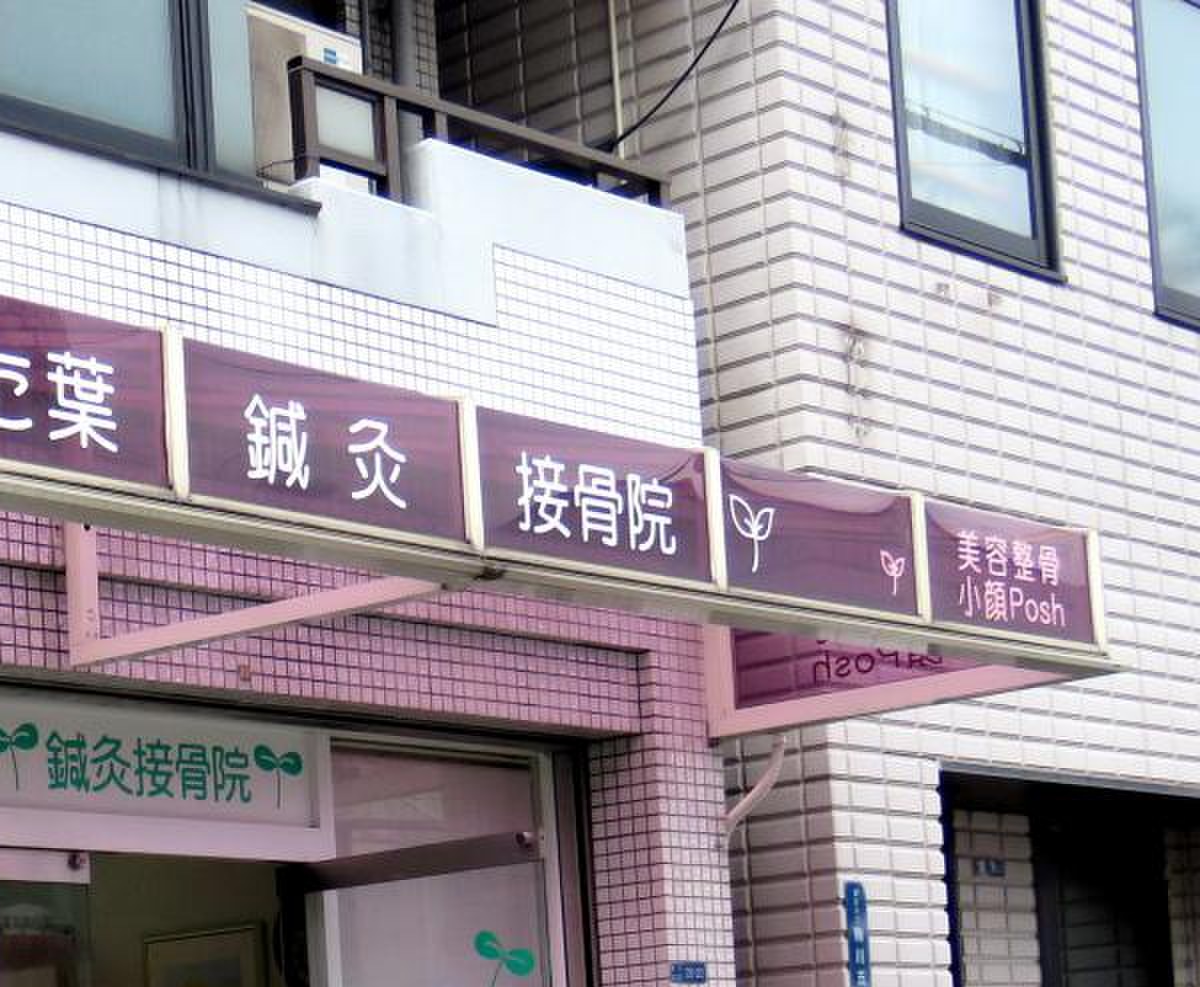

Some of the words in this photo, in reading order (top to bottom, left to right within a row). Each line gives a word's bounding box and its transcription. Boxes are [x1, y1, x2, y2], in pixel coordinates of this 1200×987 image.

[514, 450, 677, 556] 接骨院
[957, 529, 1060, 587] 美容整骨
[959, 575, 1066, 627] 小顔Posh
[45, 730, 252, 803] 鍼灸接骨院
